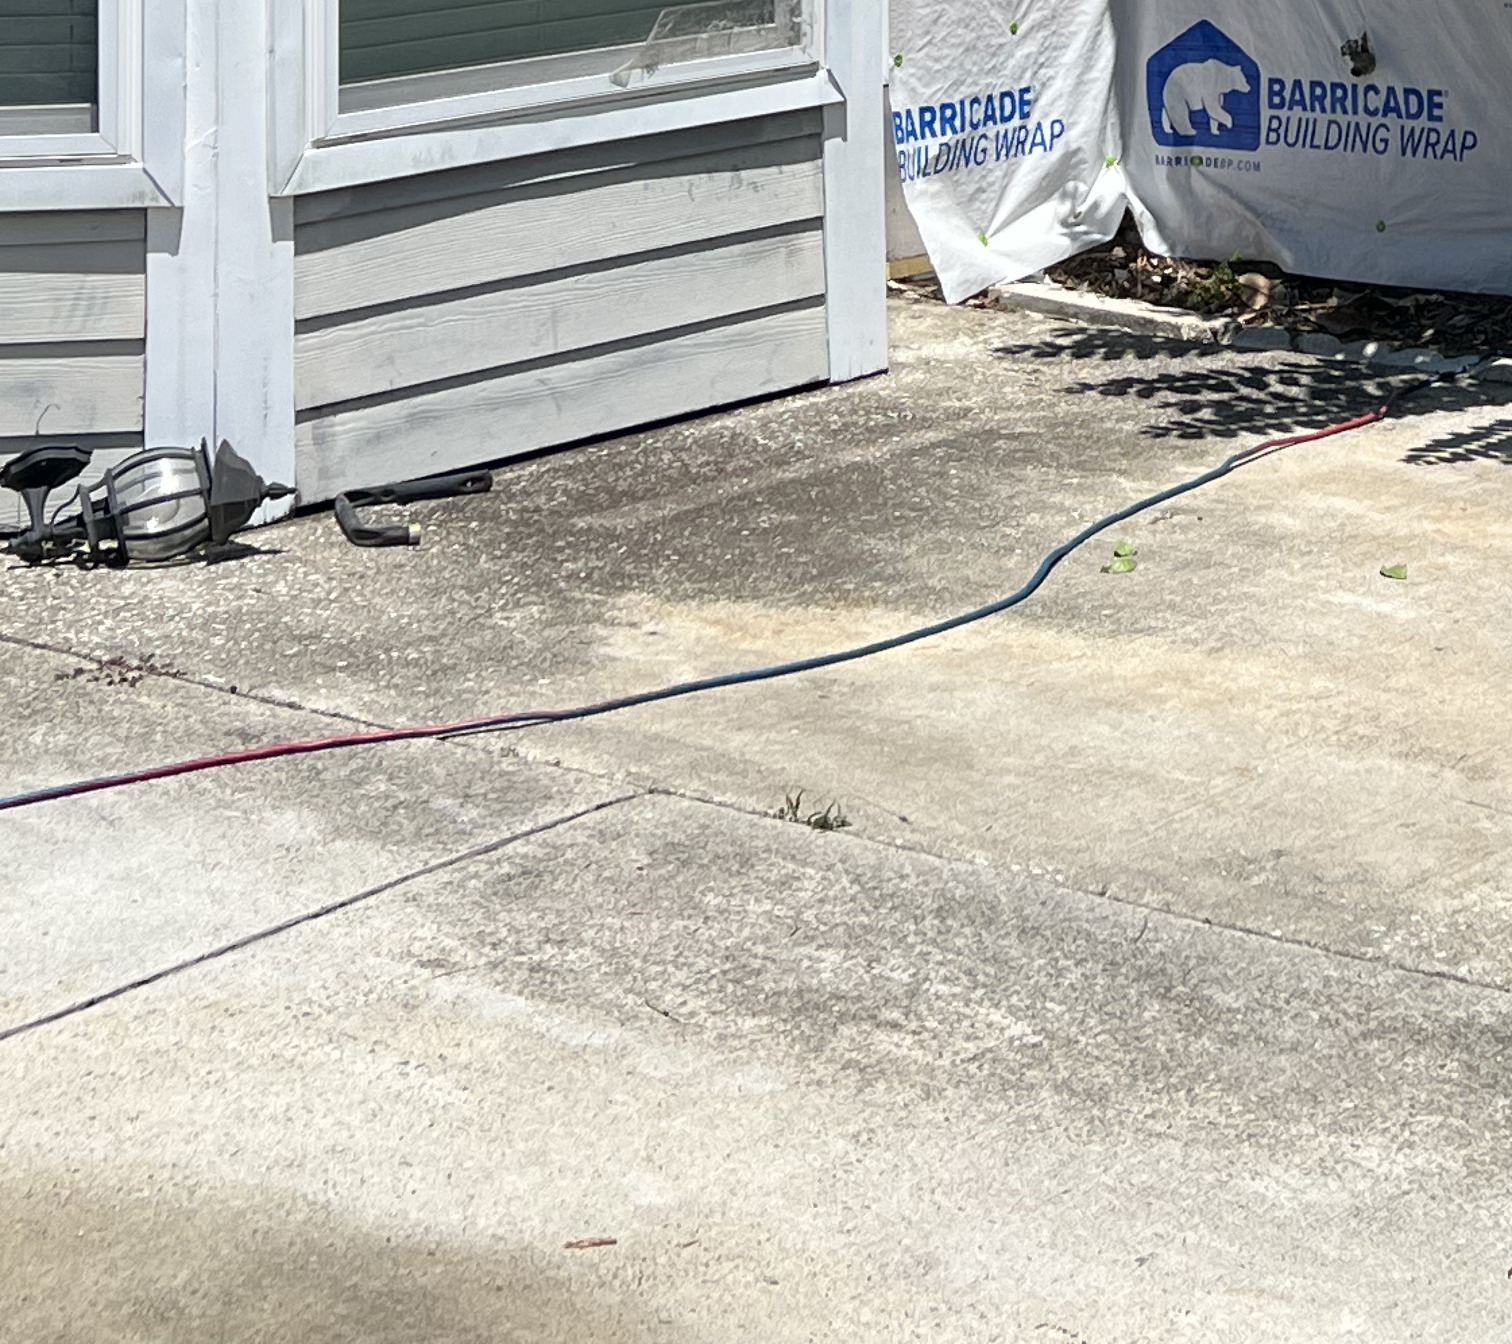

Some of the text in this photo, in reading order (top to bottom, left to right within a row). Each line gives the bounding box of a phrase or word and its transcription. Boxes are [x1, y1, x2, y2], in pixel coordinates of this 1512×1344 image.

[891, 85, 1033, 145] BARRICADE
[1267, 77, 1445, 123] BARRICADE
[897, 119, 1065, 184] BUILDING WRAP
[1264, 115, 1478, 162] BUILDING WRAP
